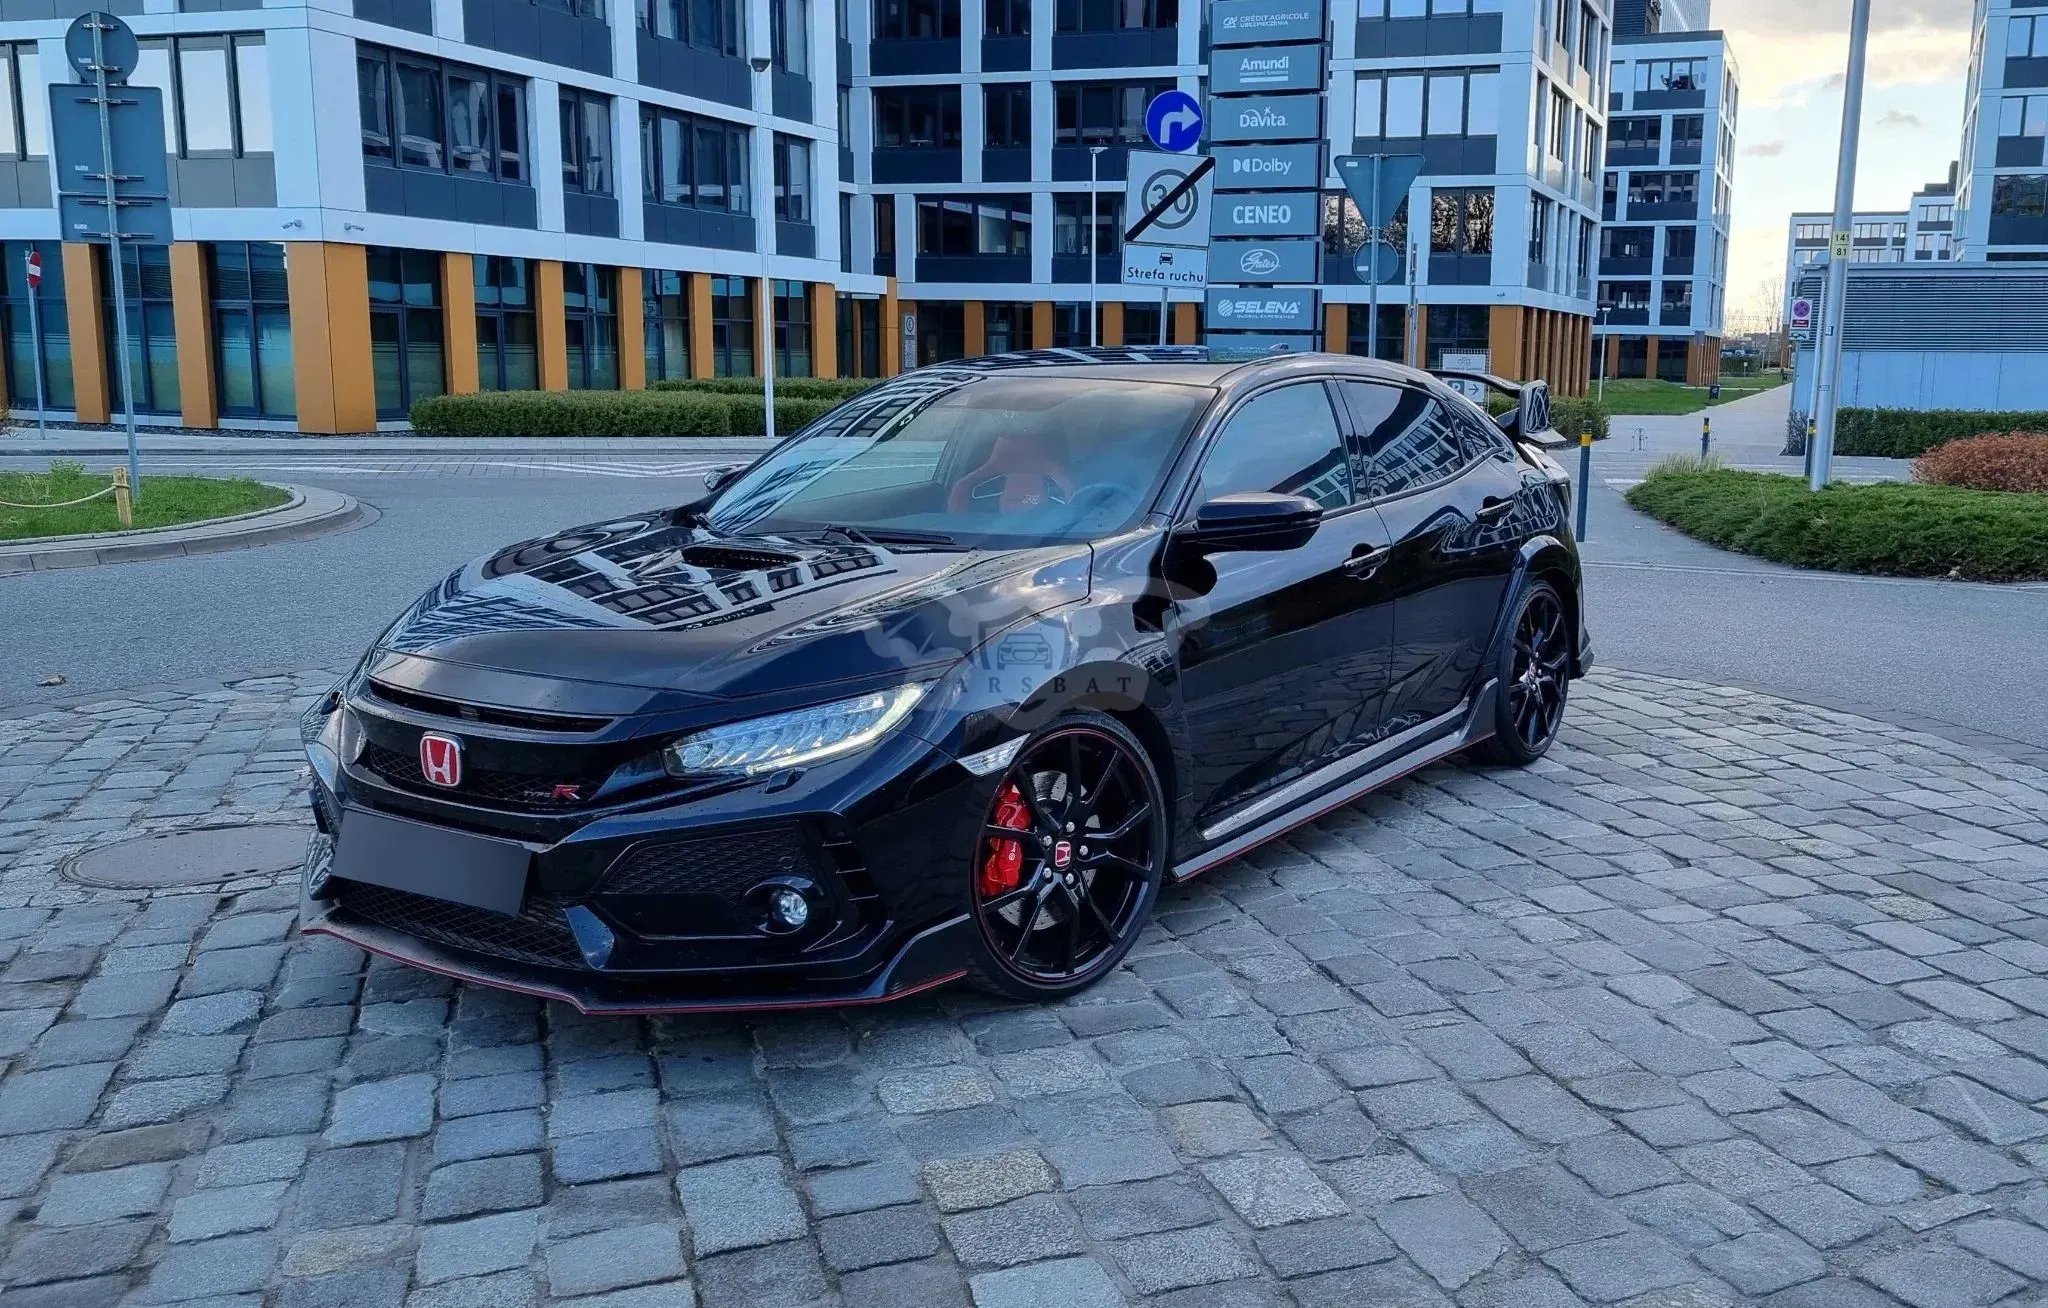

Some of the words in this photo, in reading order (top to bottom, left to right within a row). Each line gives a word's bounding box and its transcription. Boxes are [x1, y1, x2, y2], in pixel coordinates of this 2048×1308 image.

[1270, 12, 1309, 21] AGRICOLE
[1240, 56, 1289, 71] Amundi
[1252, 158, 1292, 175] Dolby
[1233, 205, 1291, 224] CENEO
[1836, 248, 1847, 256] 81
[1242, 252, 1277, 272] Gates
[1128, 267, 1165, 280] Strefa
[1170, 270, 1204, 282] ruchu
[1233, 301, 1299, 314] SELENA
